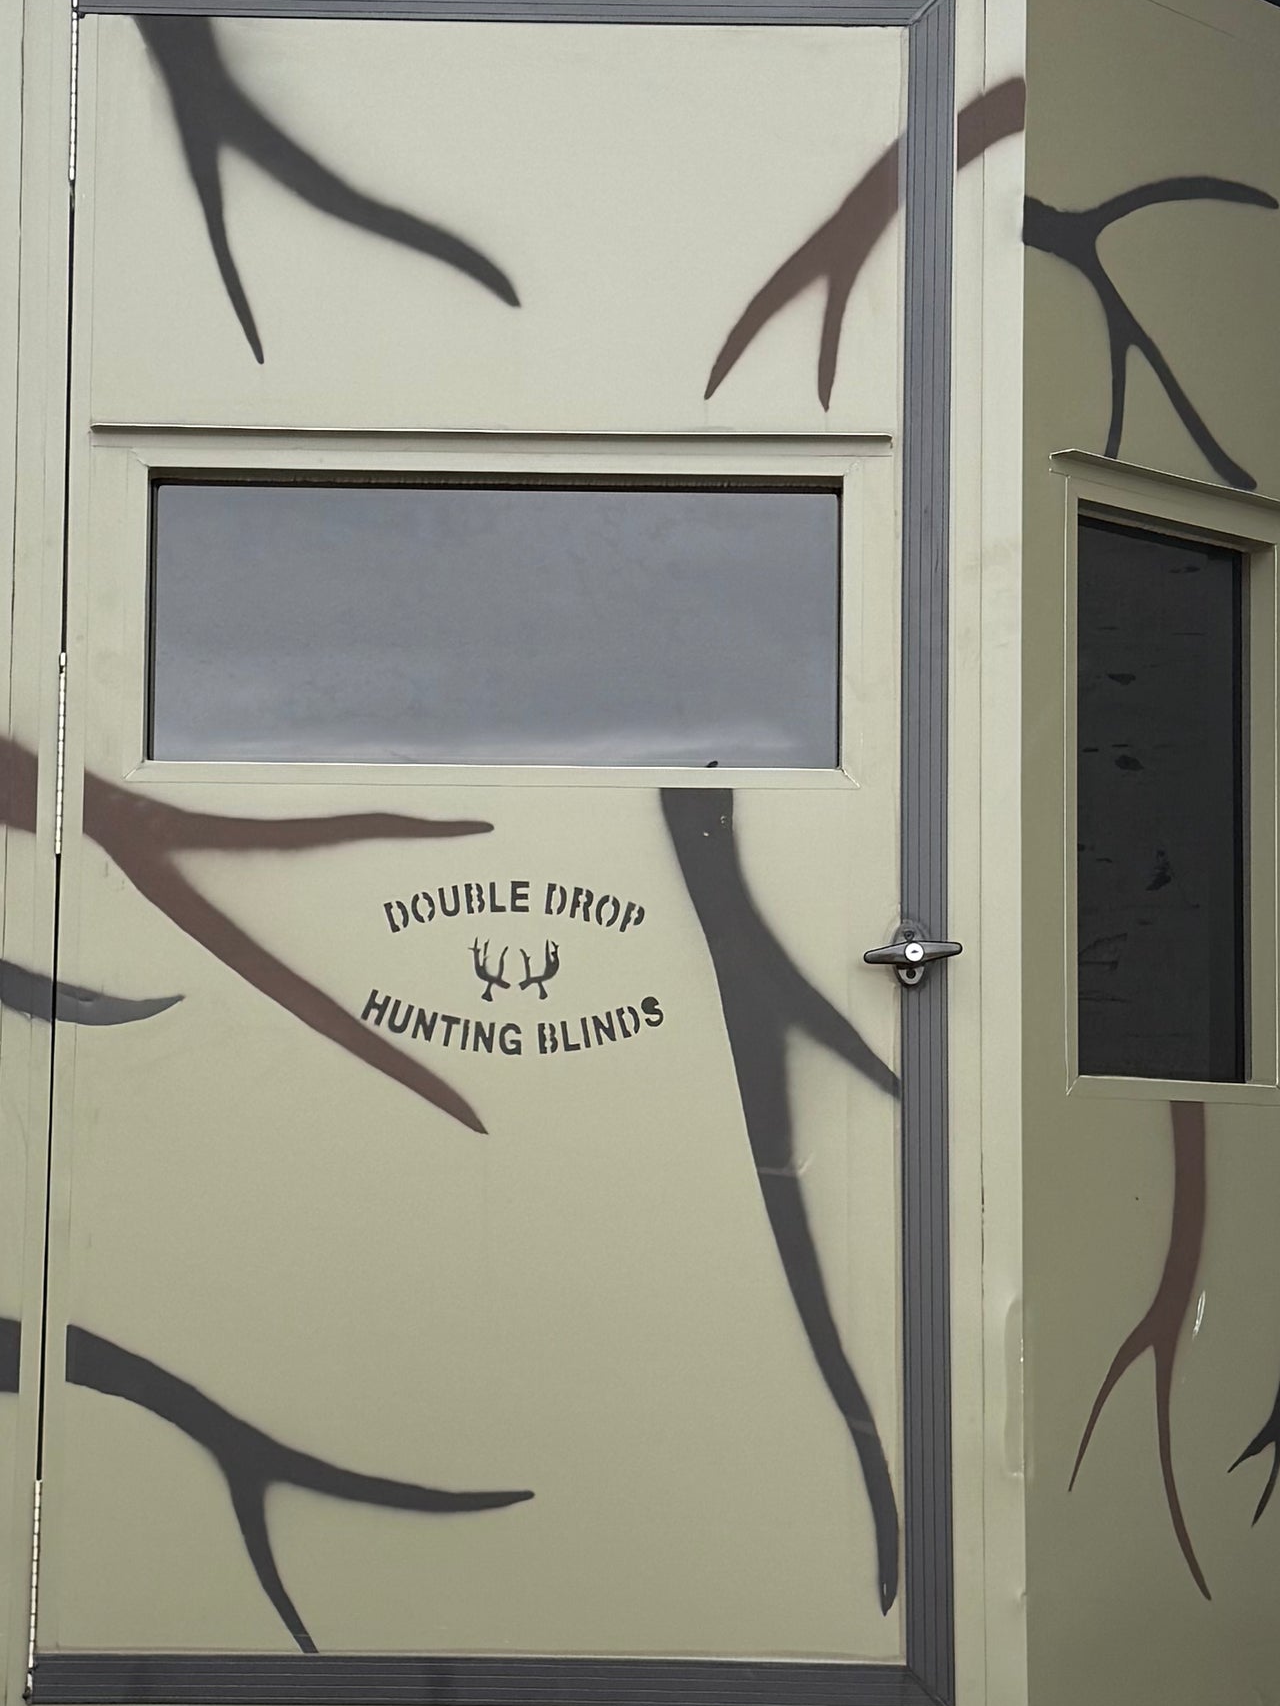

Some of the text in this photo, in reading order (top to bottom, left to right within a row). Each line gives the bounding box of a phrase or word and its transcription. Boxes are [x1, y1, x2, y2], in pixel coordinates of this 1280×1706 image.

[383, 880, 646, 933] DOUBLE DROP
[360, 989, 664, 1055] HUNTING BLINDS
